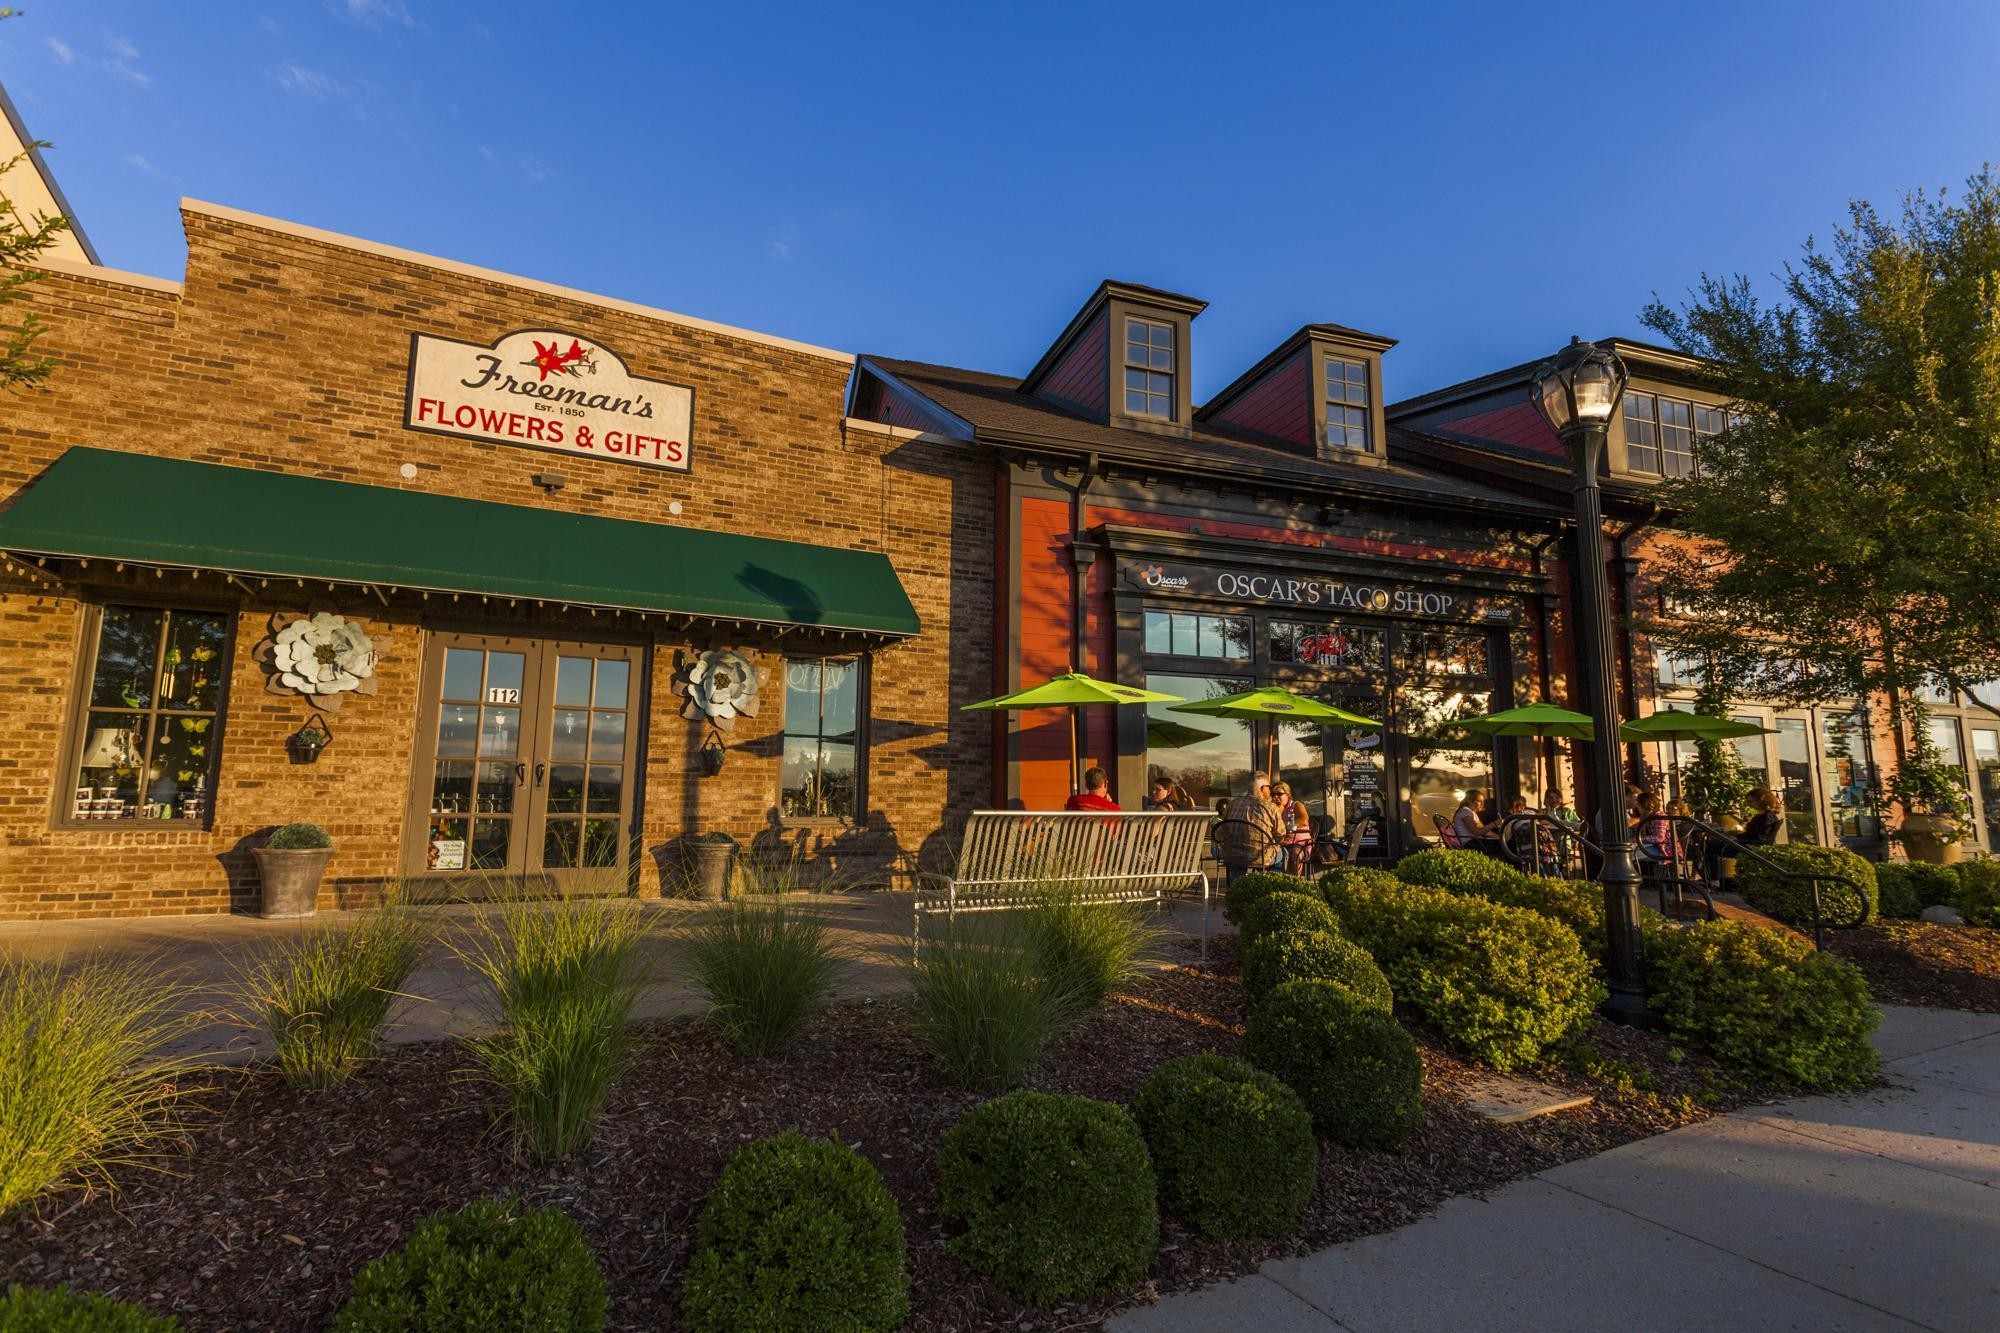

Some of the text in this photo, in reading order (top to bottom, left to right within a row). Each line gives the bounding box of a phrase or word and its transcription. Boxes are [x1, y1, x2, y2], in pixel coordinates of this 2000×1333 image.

[461, 354, 653, 419] Freeman's
[560, 406, 585, 418] 1850
[418, 398, 683, 463] FLOWERS & GIFTS
[1147, 573, 1190, 586] Oscar's
[1217, 573, 1453, 615] OSCAR'S TACO SHOP
[789, 663, 842, 688] OPEN
[492, 689, 518, 703] 112
